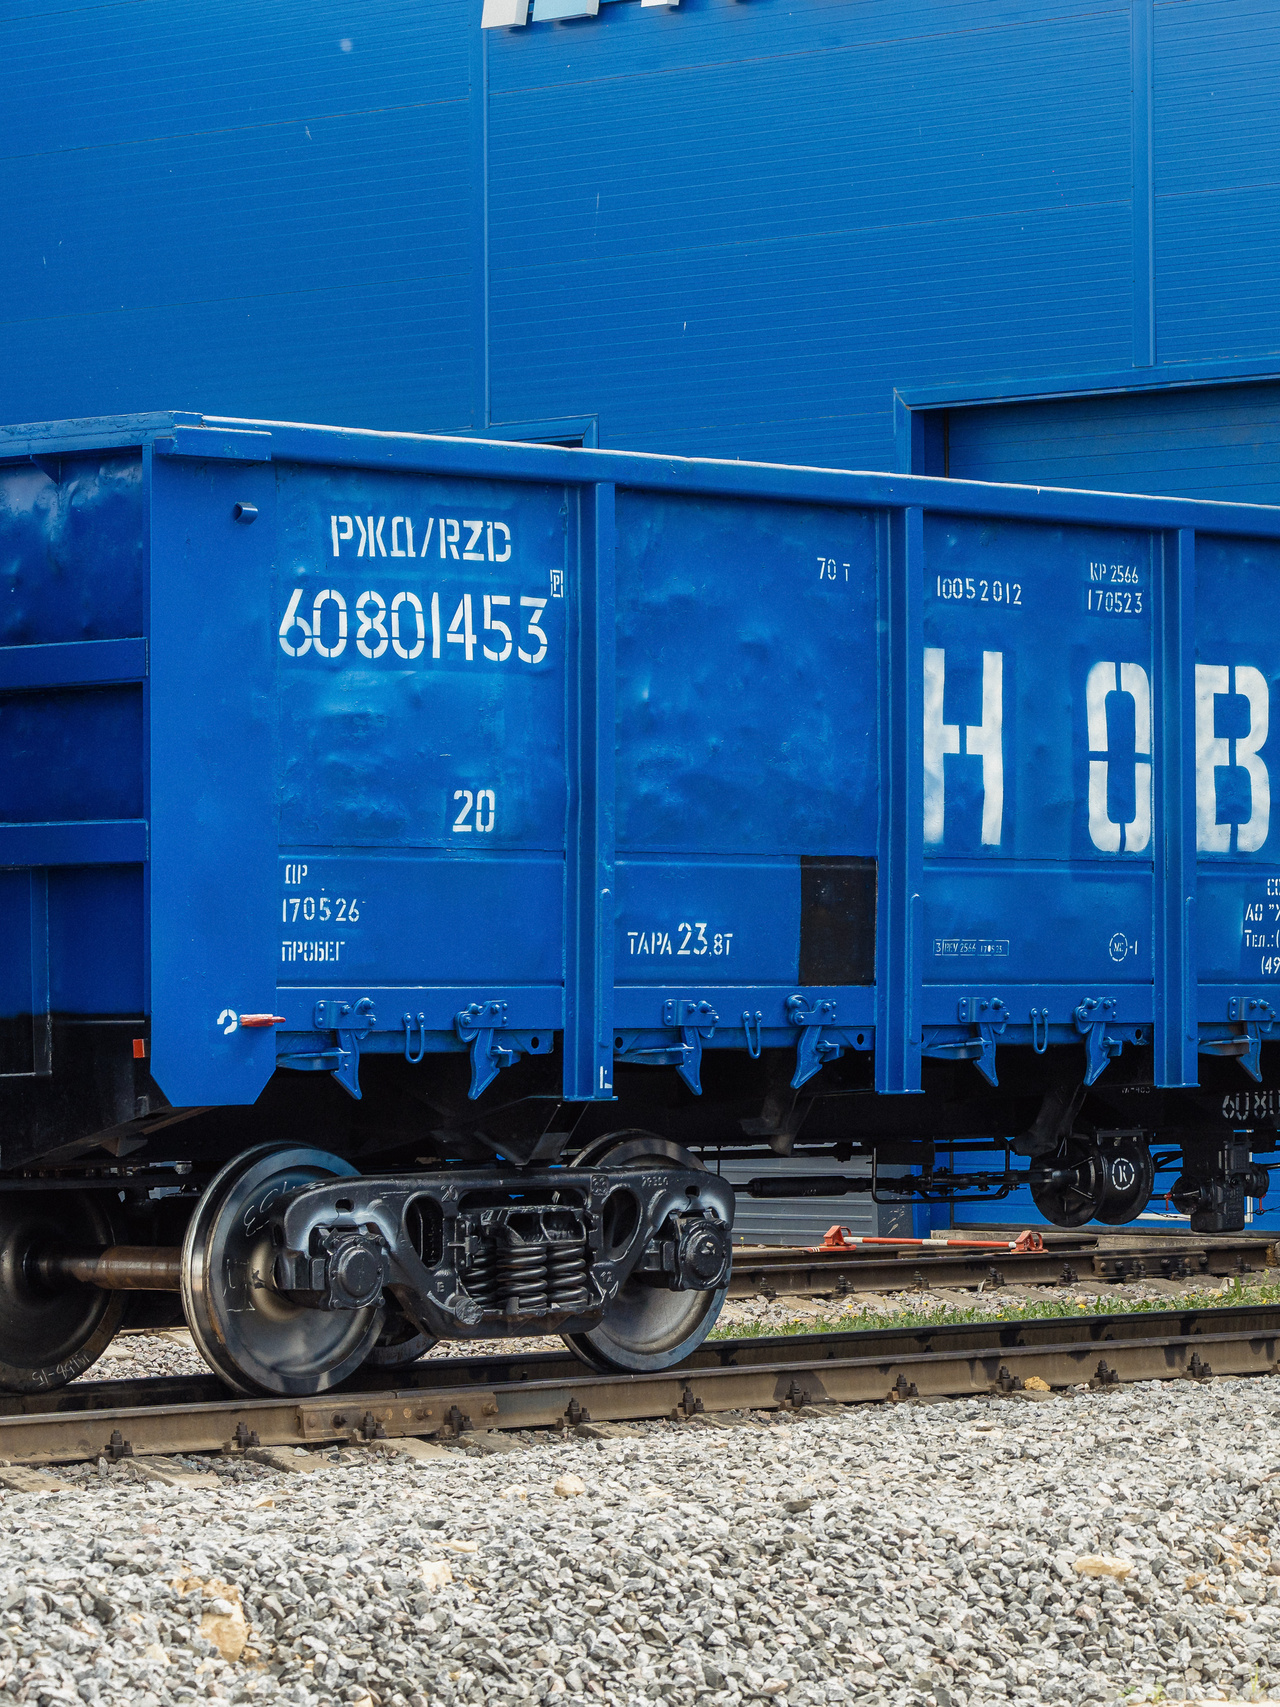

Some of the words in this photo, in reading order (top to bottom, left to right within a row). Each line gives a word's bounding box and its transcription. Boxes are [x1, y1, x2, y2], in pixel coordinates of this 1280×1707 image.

[330, 515, 512, 562] РЖД/RZD
[817, 557, 836, 581] 70
[1090, 562, 1107, 581] КР
[1110, 565, 1139, 583] 2566
[937, 575, 1022, 605] 10052012
[1088, 589, 1143, 613] 170523
[278, 588, 548, 664] 60801453
[452, 789, 496, 833] 20
[282, 898, 360, 923] 170526
[1244, 904, 1263, 921] АО
[281, 941, 345, 962] ПРОБЕГ
[627, 931, 673, 956] ТАРА
